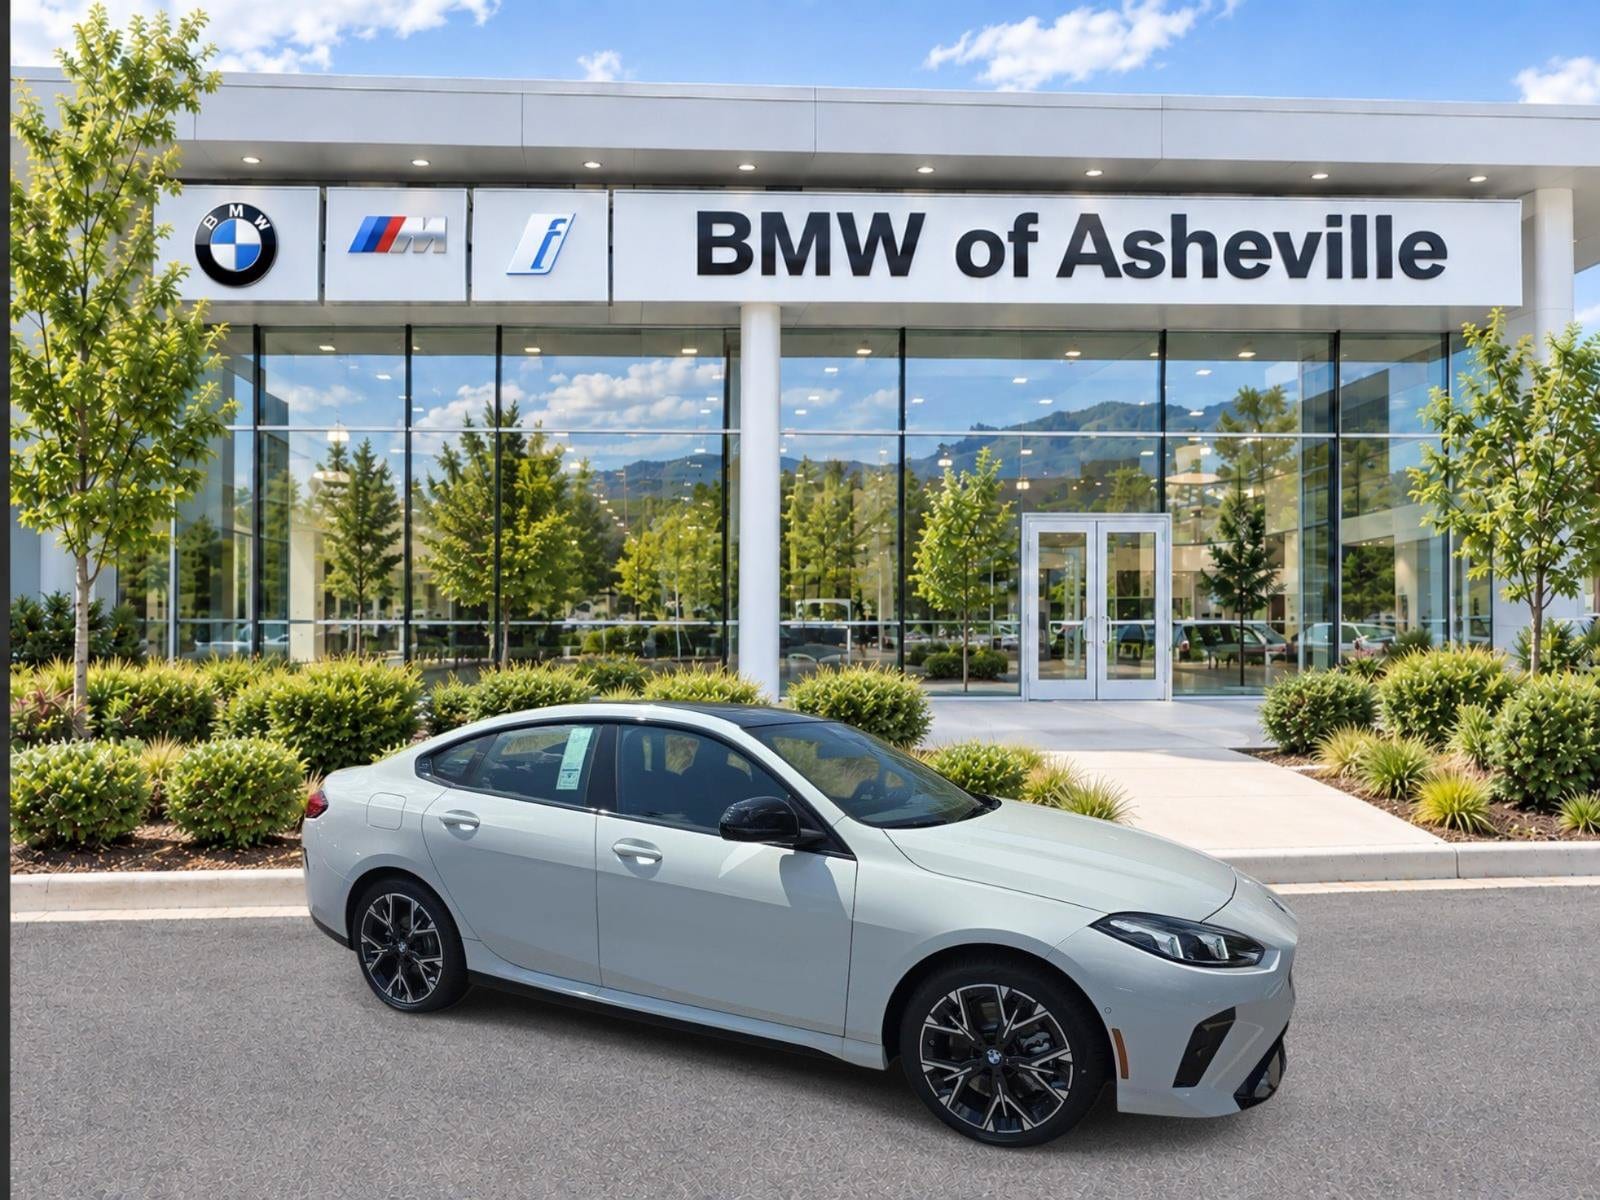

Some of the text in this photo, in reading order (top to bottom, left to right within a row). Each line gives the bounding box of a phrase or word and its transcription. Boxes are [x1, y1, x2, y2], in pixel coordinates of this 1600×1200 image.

[202, 203, 271, 231] BMW
[389, 216, 448, 254] M
[696, 210, 1448, 280] BMW of Asheville
